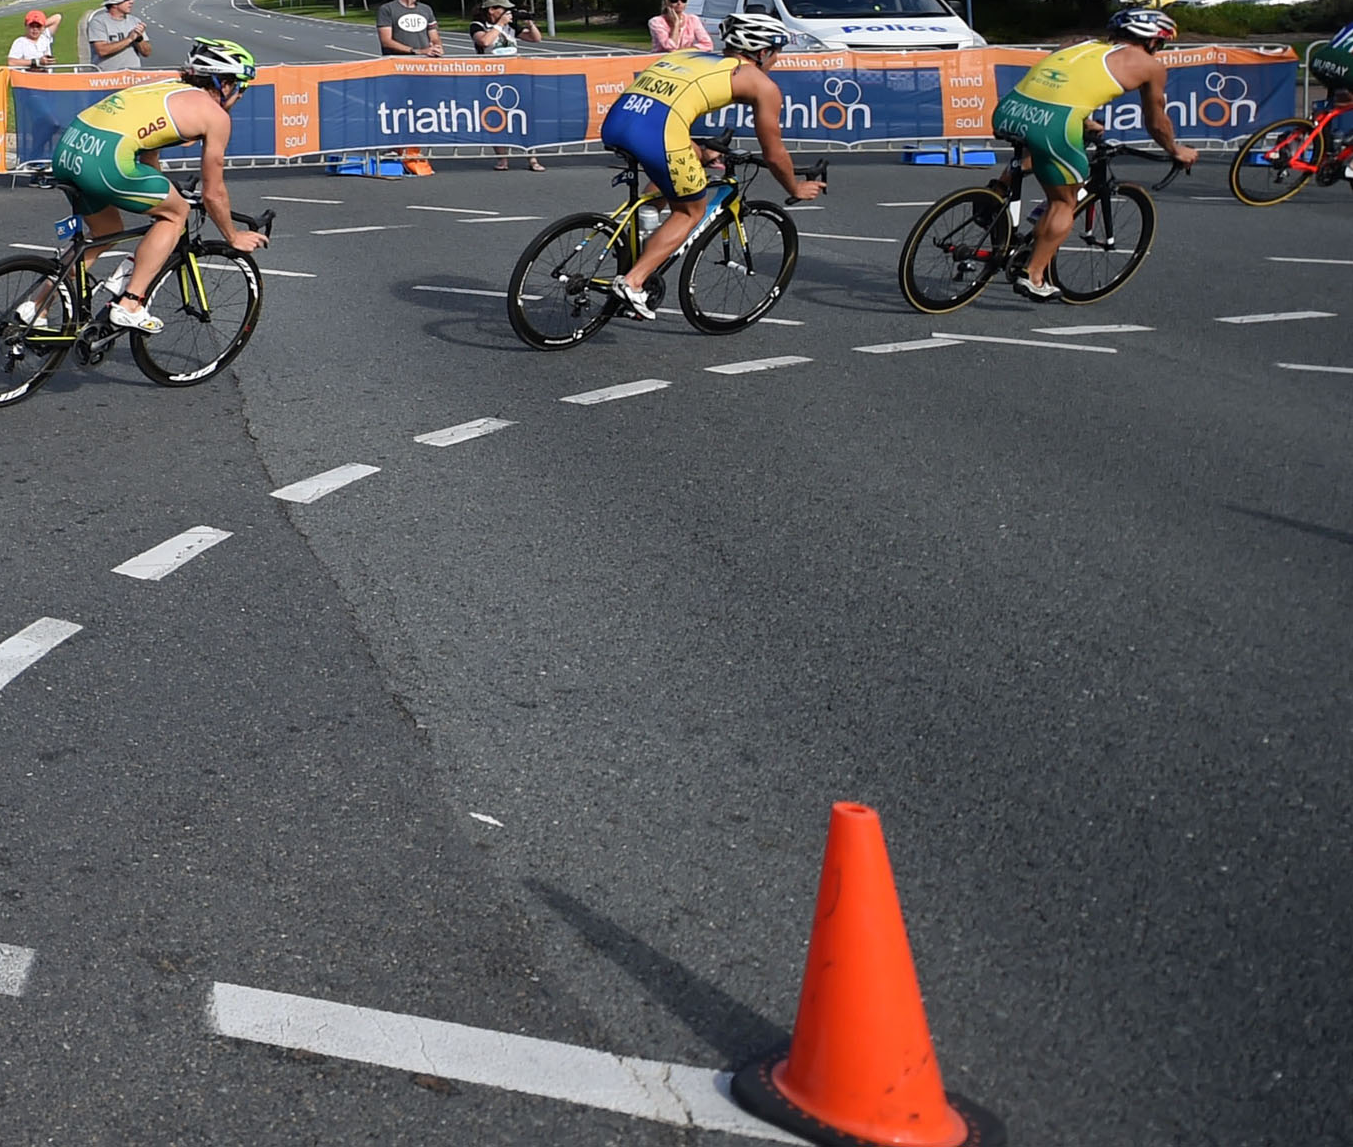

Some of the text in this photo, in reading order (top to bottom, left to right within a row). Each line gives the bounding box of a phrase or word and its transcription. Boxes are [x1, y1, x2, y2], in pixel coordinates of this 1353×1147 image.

[841, 24, 947, 34] Police
[394, 61, 506, 73] www.triathlon.org
[775, 57, 844, 69] athlon.org
[950, 74, 983, 87] mind
[596, 82, 625, 94] mind
[282, 91, 308, 105] mind
[623, 94, 654, 115] BAR
[952, 95, 985, 109] body
[597, 102, 612, 115] bo
[282, 114, 309, 129] body
[378, 100, 527, 136] triathlon
[955, 115, 983, 128] soul
[137, 117, 167, 140] QAS
[285, 133, 307, 148] soul
[58, 150, 83, 175] AUS
[621, 171, 635, 180] 20
